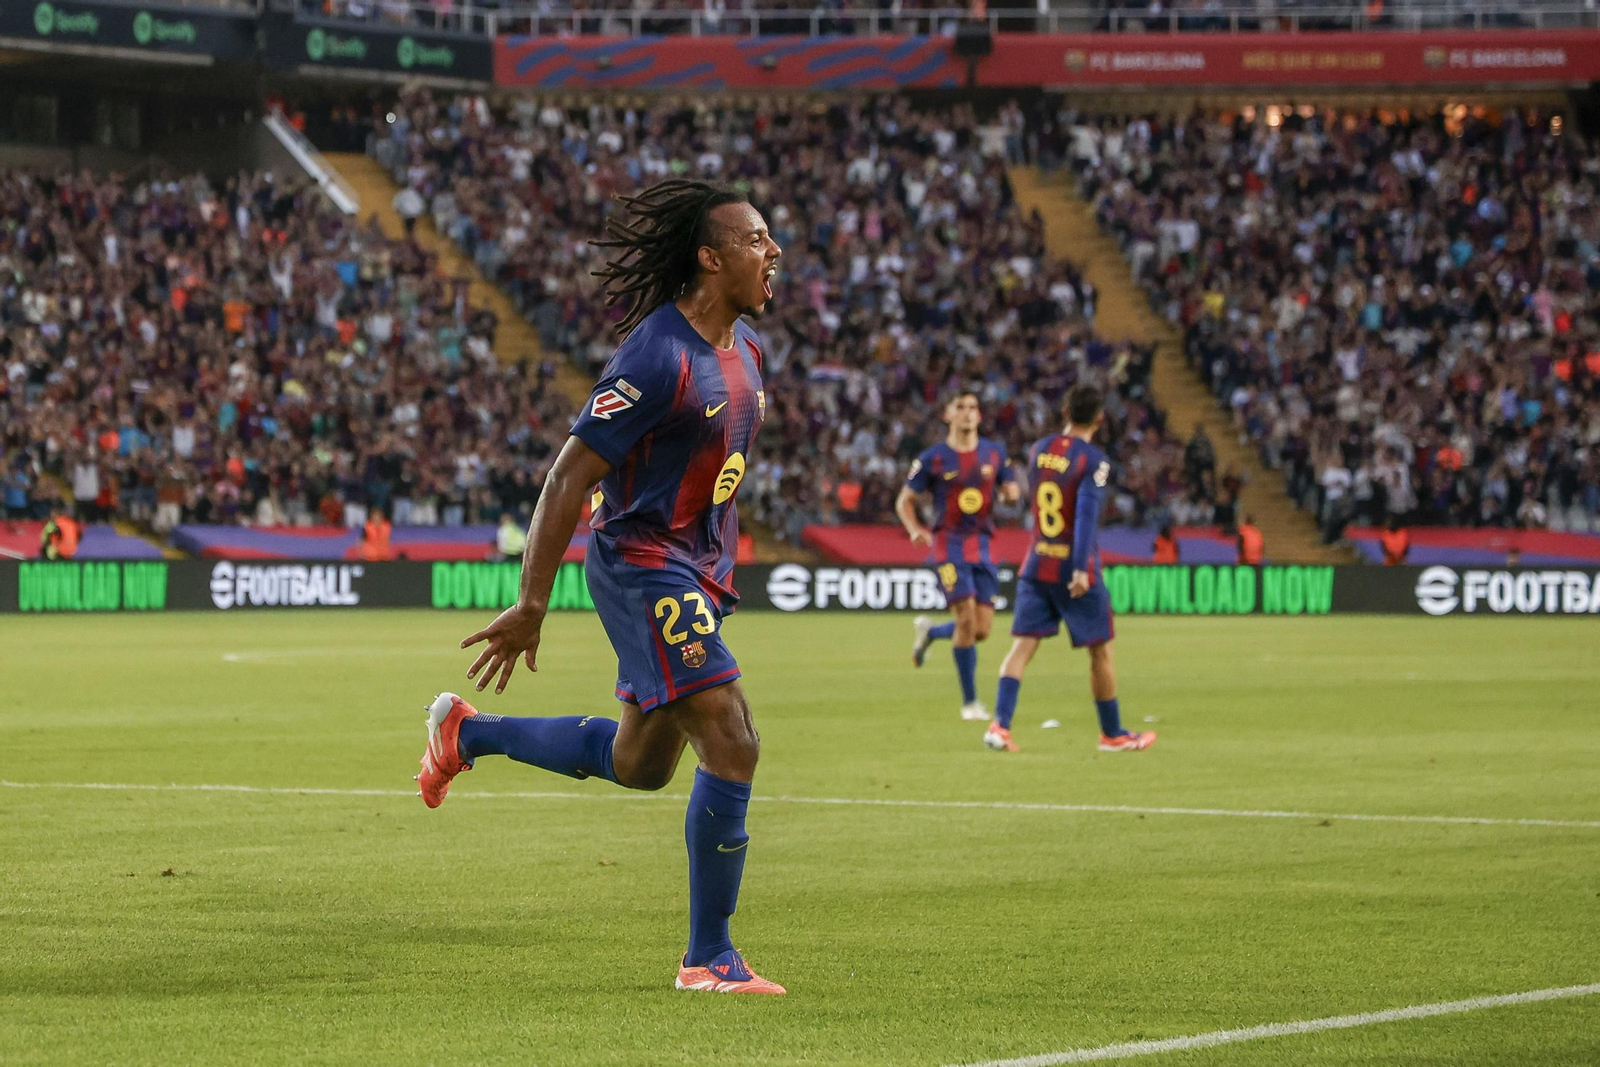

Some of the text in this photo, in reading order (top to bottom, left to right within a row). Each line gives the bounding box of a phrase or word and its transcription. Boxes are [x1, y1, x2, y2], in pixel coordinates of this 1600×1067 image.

[1036, 481, 1065, 538] 8
[19, 562, 168, 611] DOWNLOAD NOW
[1262, 566, 1335, 614] NOW
[654, 591, 716, 646] 23
